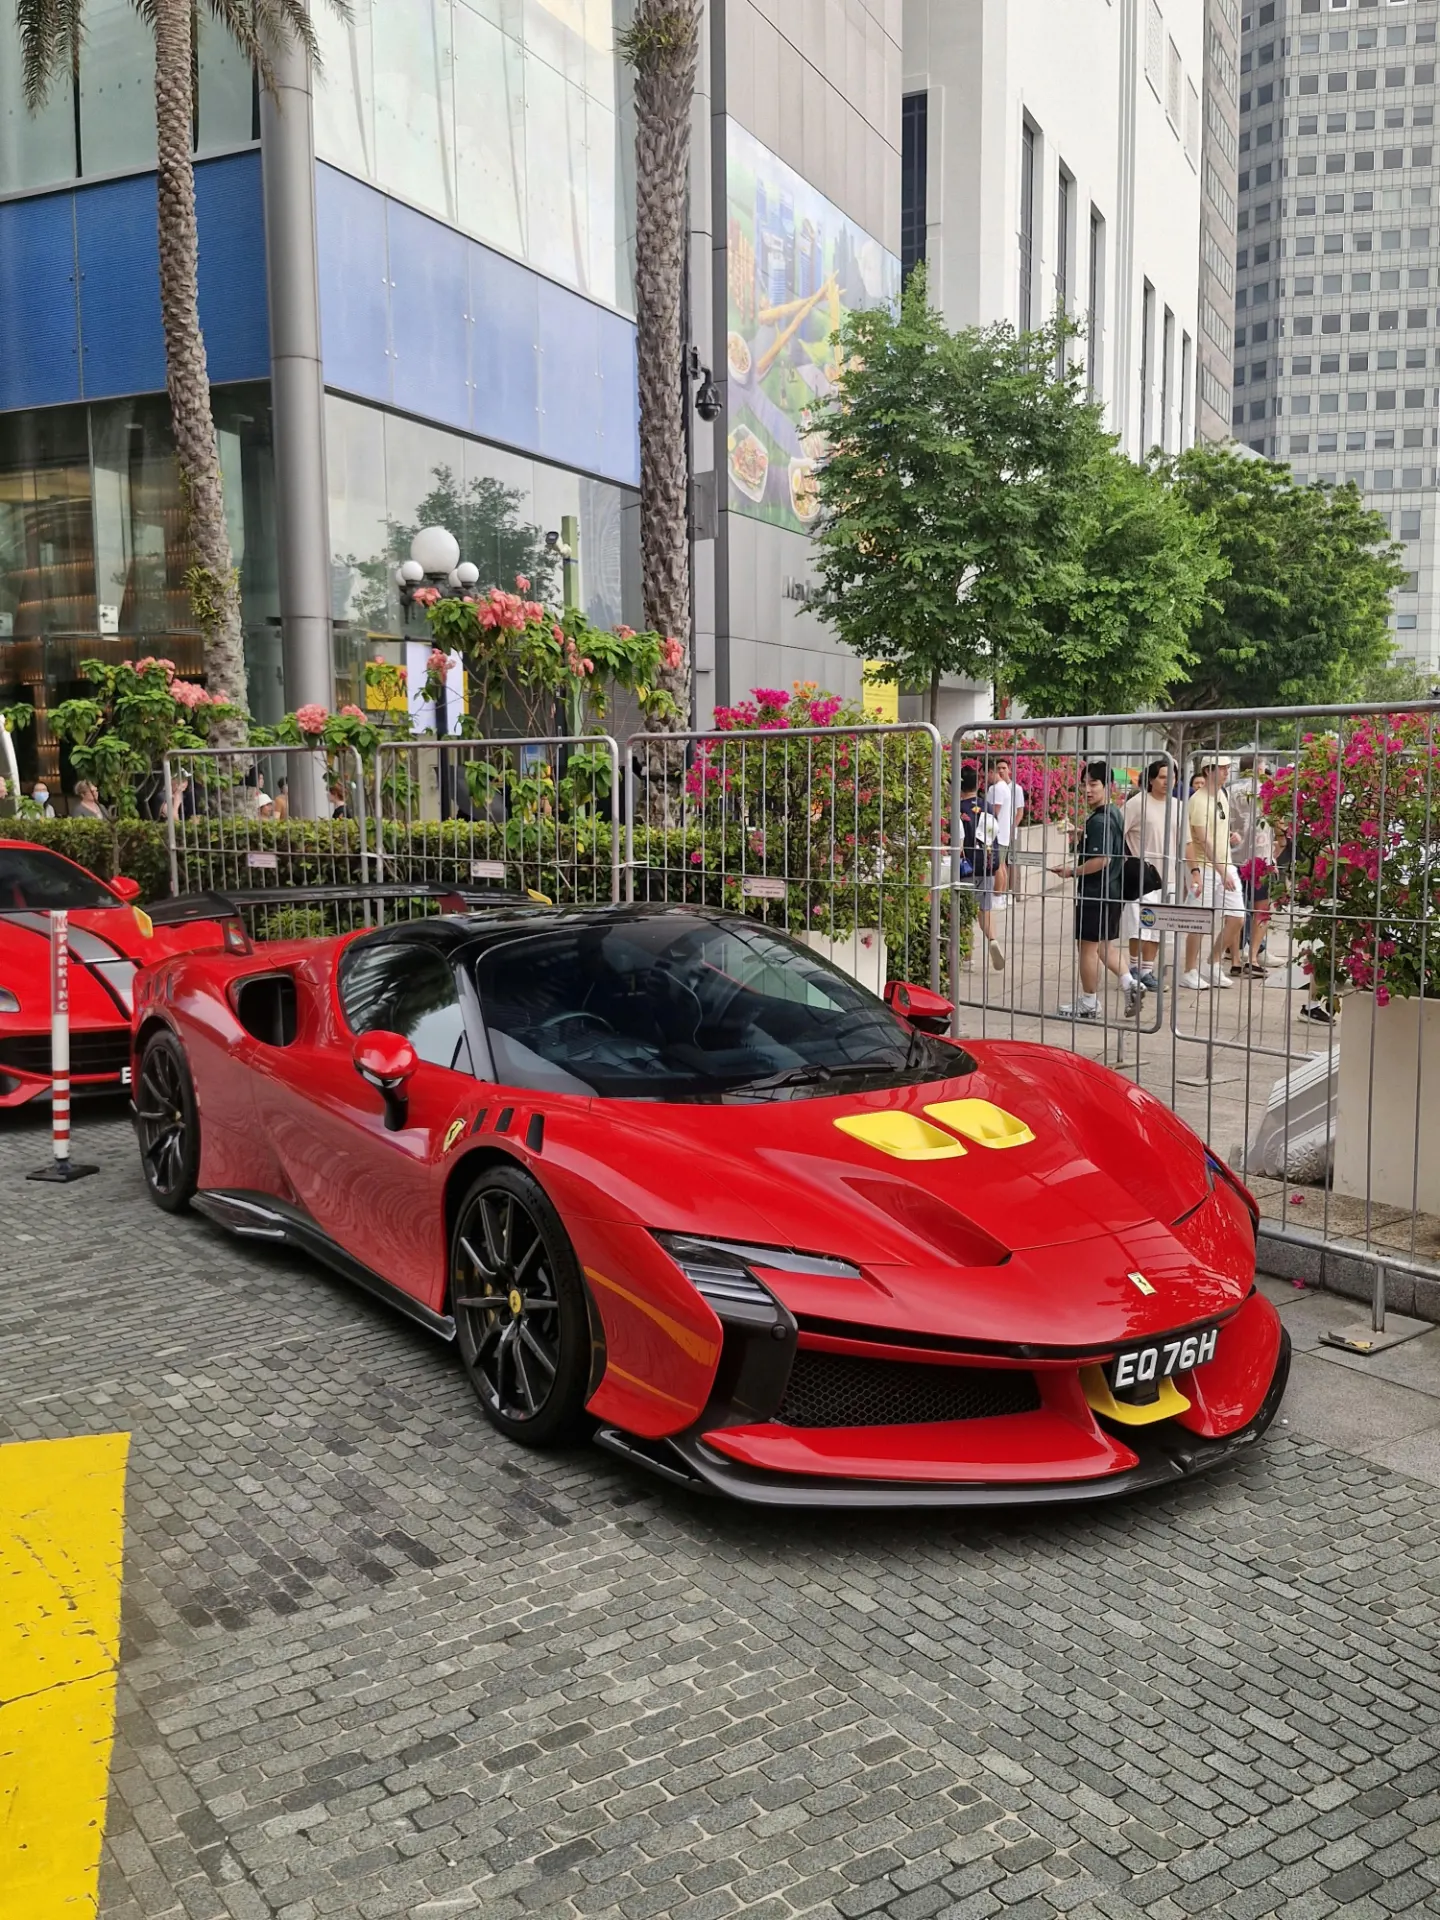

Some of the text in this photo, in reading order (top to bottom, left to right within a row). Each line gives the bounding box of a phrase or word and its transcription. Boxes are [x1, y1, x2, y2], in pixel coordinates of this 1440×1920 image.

[57, 933, 69, 1011] PARKING
[1115, 1329, 1218, 1388] EQ 76H
